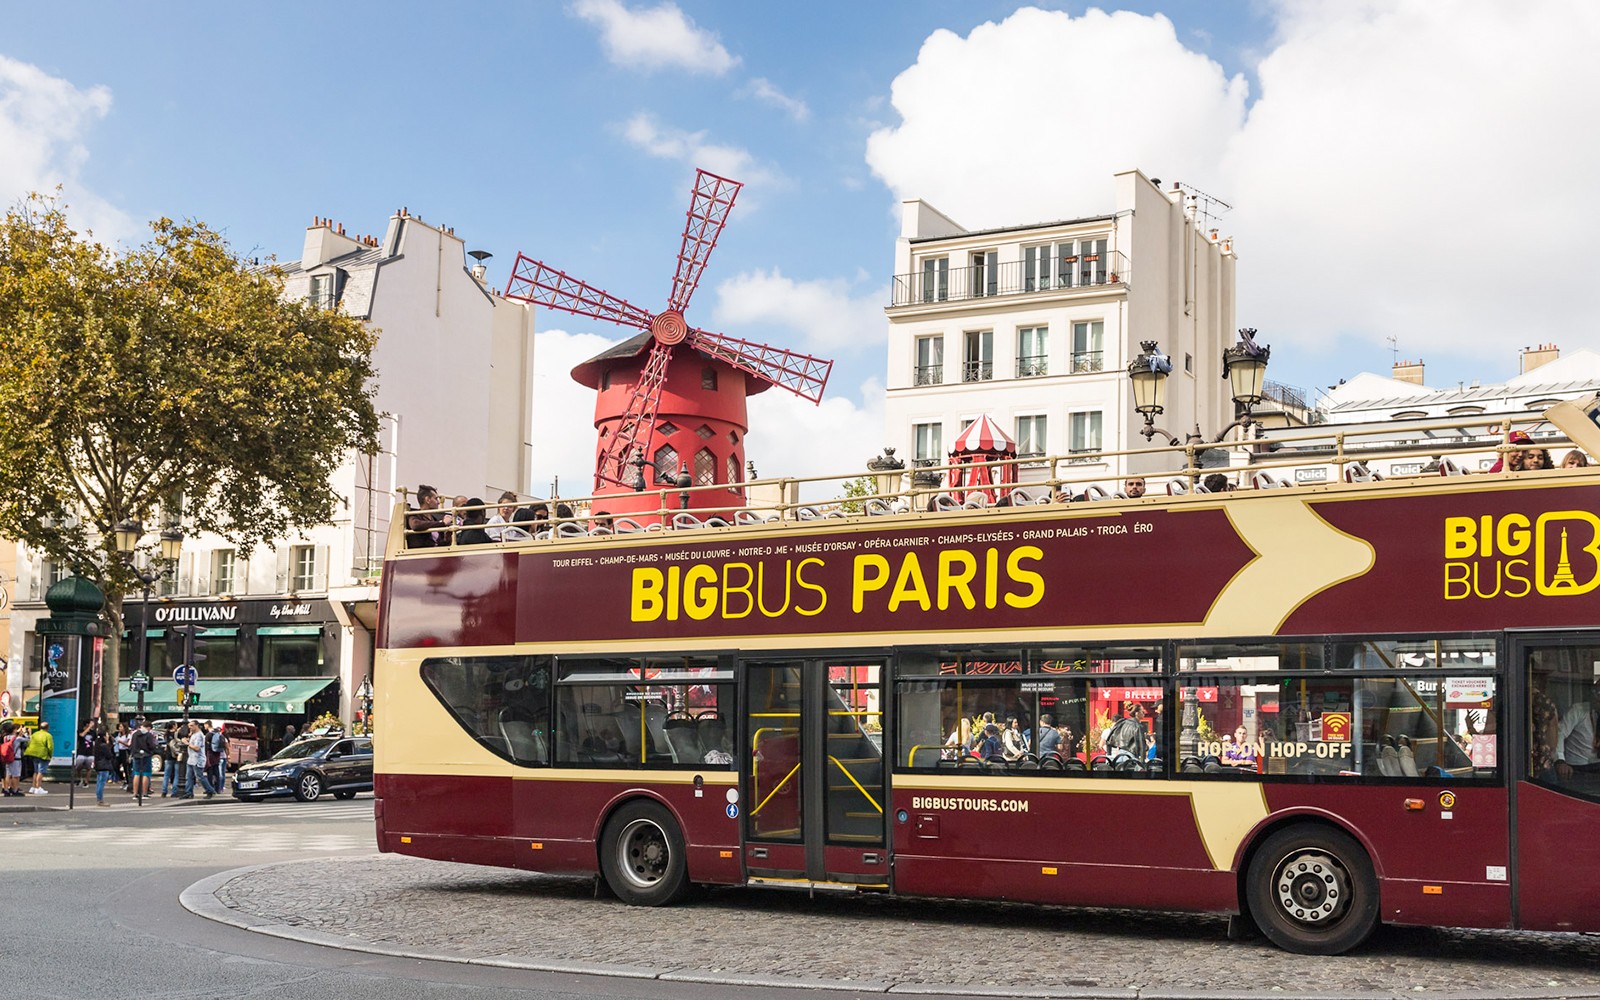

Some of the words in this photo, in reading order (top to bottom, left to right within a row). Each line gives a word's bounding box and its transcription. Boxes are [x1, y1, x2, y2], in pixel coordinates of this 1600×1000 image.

[1296, 469, 1326, 481] Quick
[1444, 513, 1532, 559] BIG
[552, 559, 570, 568] TOUR
[571, 558, 594, 567] EIFFEL
[600, 554, 659, 565] CHAMP-DE-MARS
[691, 552, 701, 560] DU
[702, 550, 730, 559] LOUVRE
[738, 545, 788, 557] NOTRE-DME
[795, 541, 822, 553] MUSÉE
[823, 541, 857, 552] D'ORSAY
[864, 537, 891, 548] OPÉRA
[938, 530, 1014, 545] CHAMPS-ELYSÉES
[1022, 529, 1054, 539] GRAND
[1056, 527, 1088, 538] PALAIS
[1097, 522, 1153, 535] TROCAÉRO
[852, 545, 1045, 614] PARIS
[1444, 559, 1532, 600] BUS
[156, 606, 238, 622] O'SULLIVANS
[270, 605, 281, 619] By
[281, 604, 294, 615] the
[293, 603, 311, 615] Mill
[1197, 741, 1265, 758] HOP-ON
[1270, 742, 1352, 758] HOP-OFF
[912, 796, 1029, 813] BIGBUSTOURS.COM
